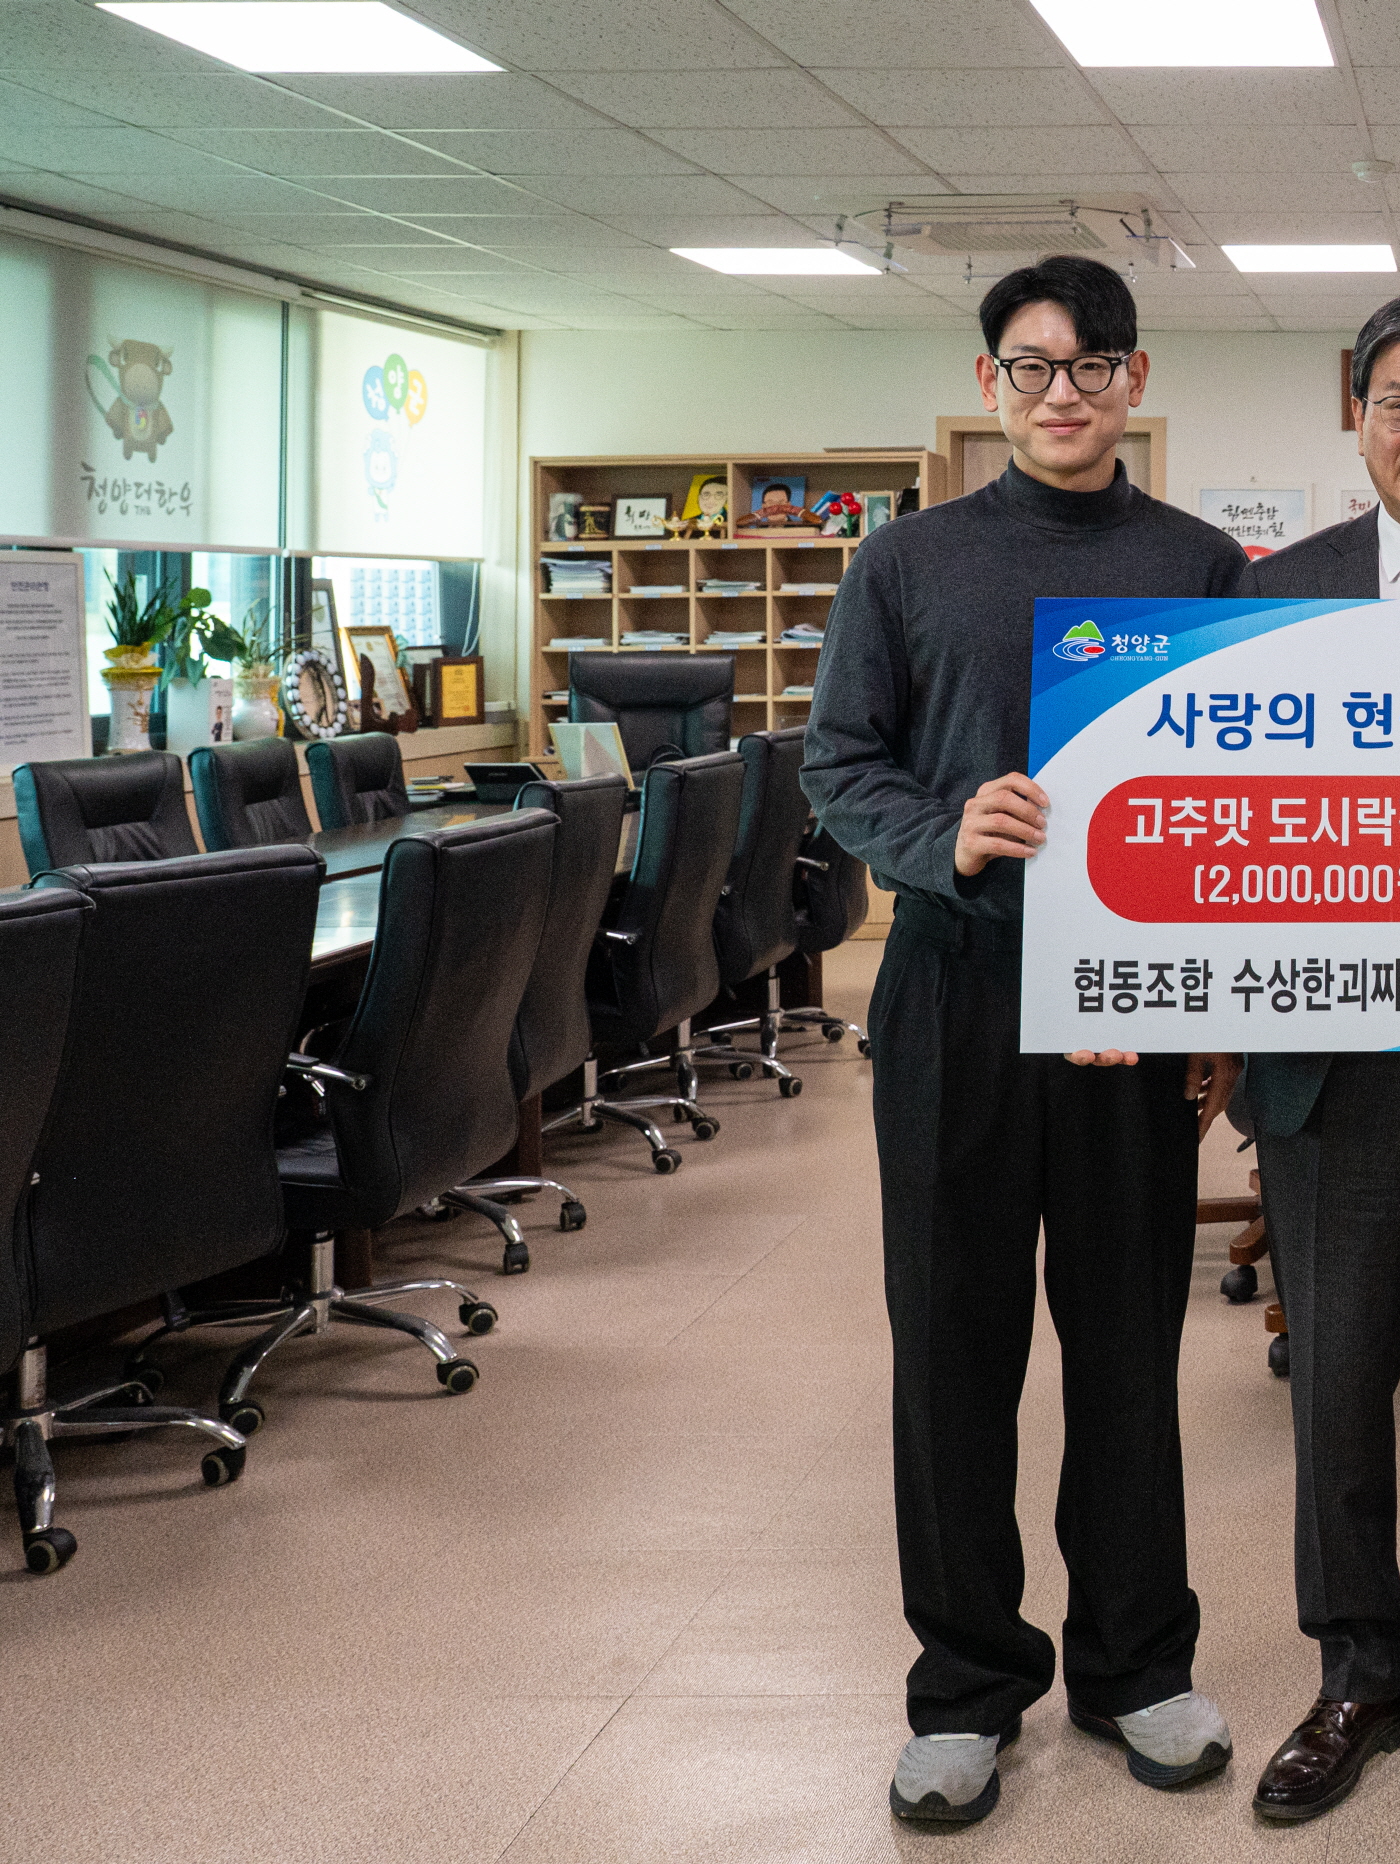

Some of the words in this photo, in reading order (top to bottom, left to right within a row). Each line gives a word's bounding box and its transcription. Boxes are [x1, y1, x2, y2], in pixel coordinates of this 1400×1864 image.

[1111, 634, 1171, 654] 청양군
[1147, 691, 1315, 751] 사랑의
[1124, 797, 1253, 848] 고추맛
[1074, 958, 1213, 1014] 협동조합
